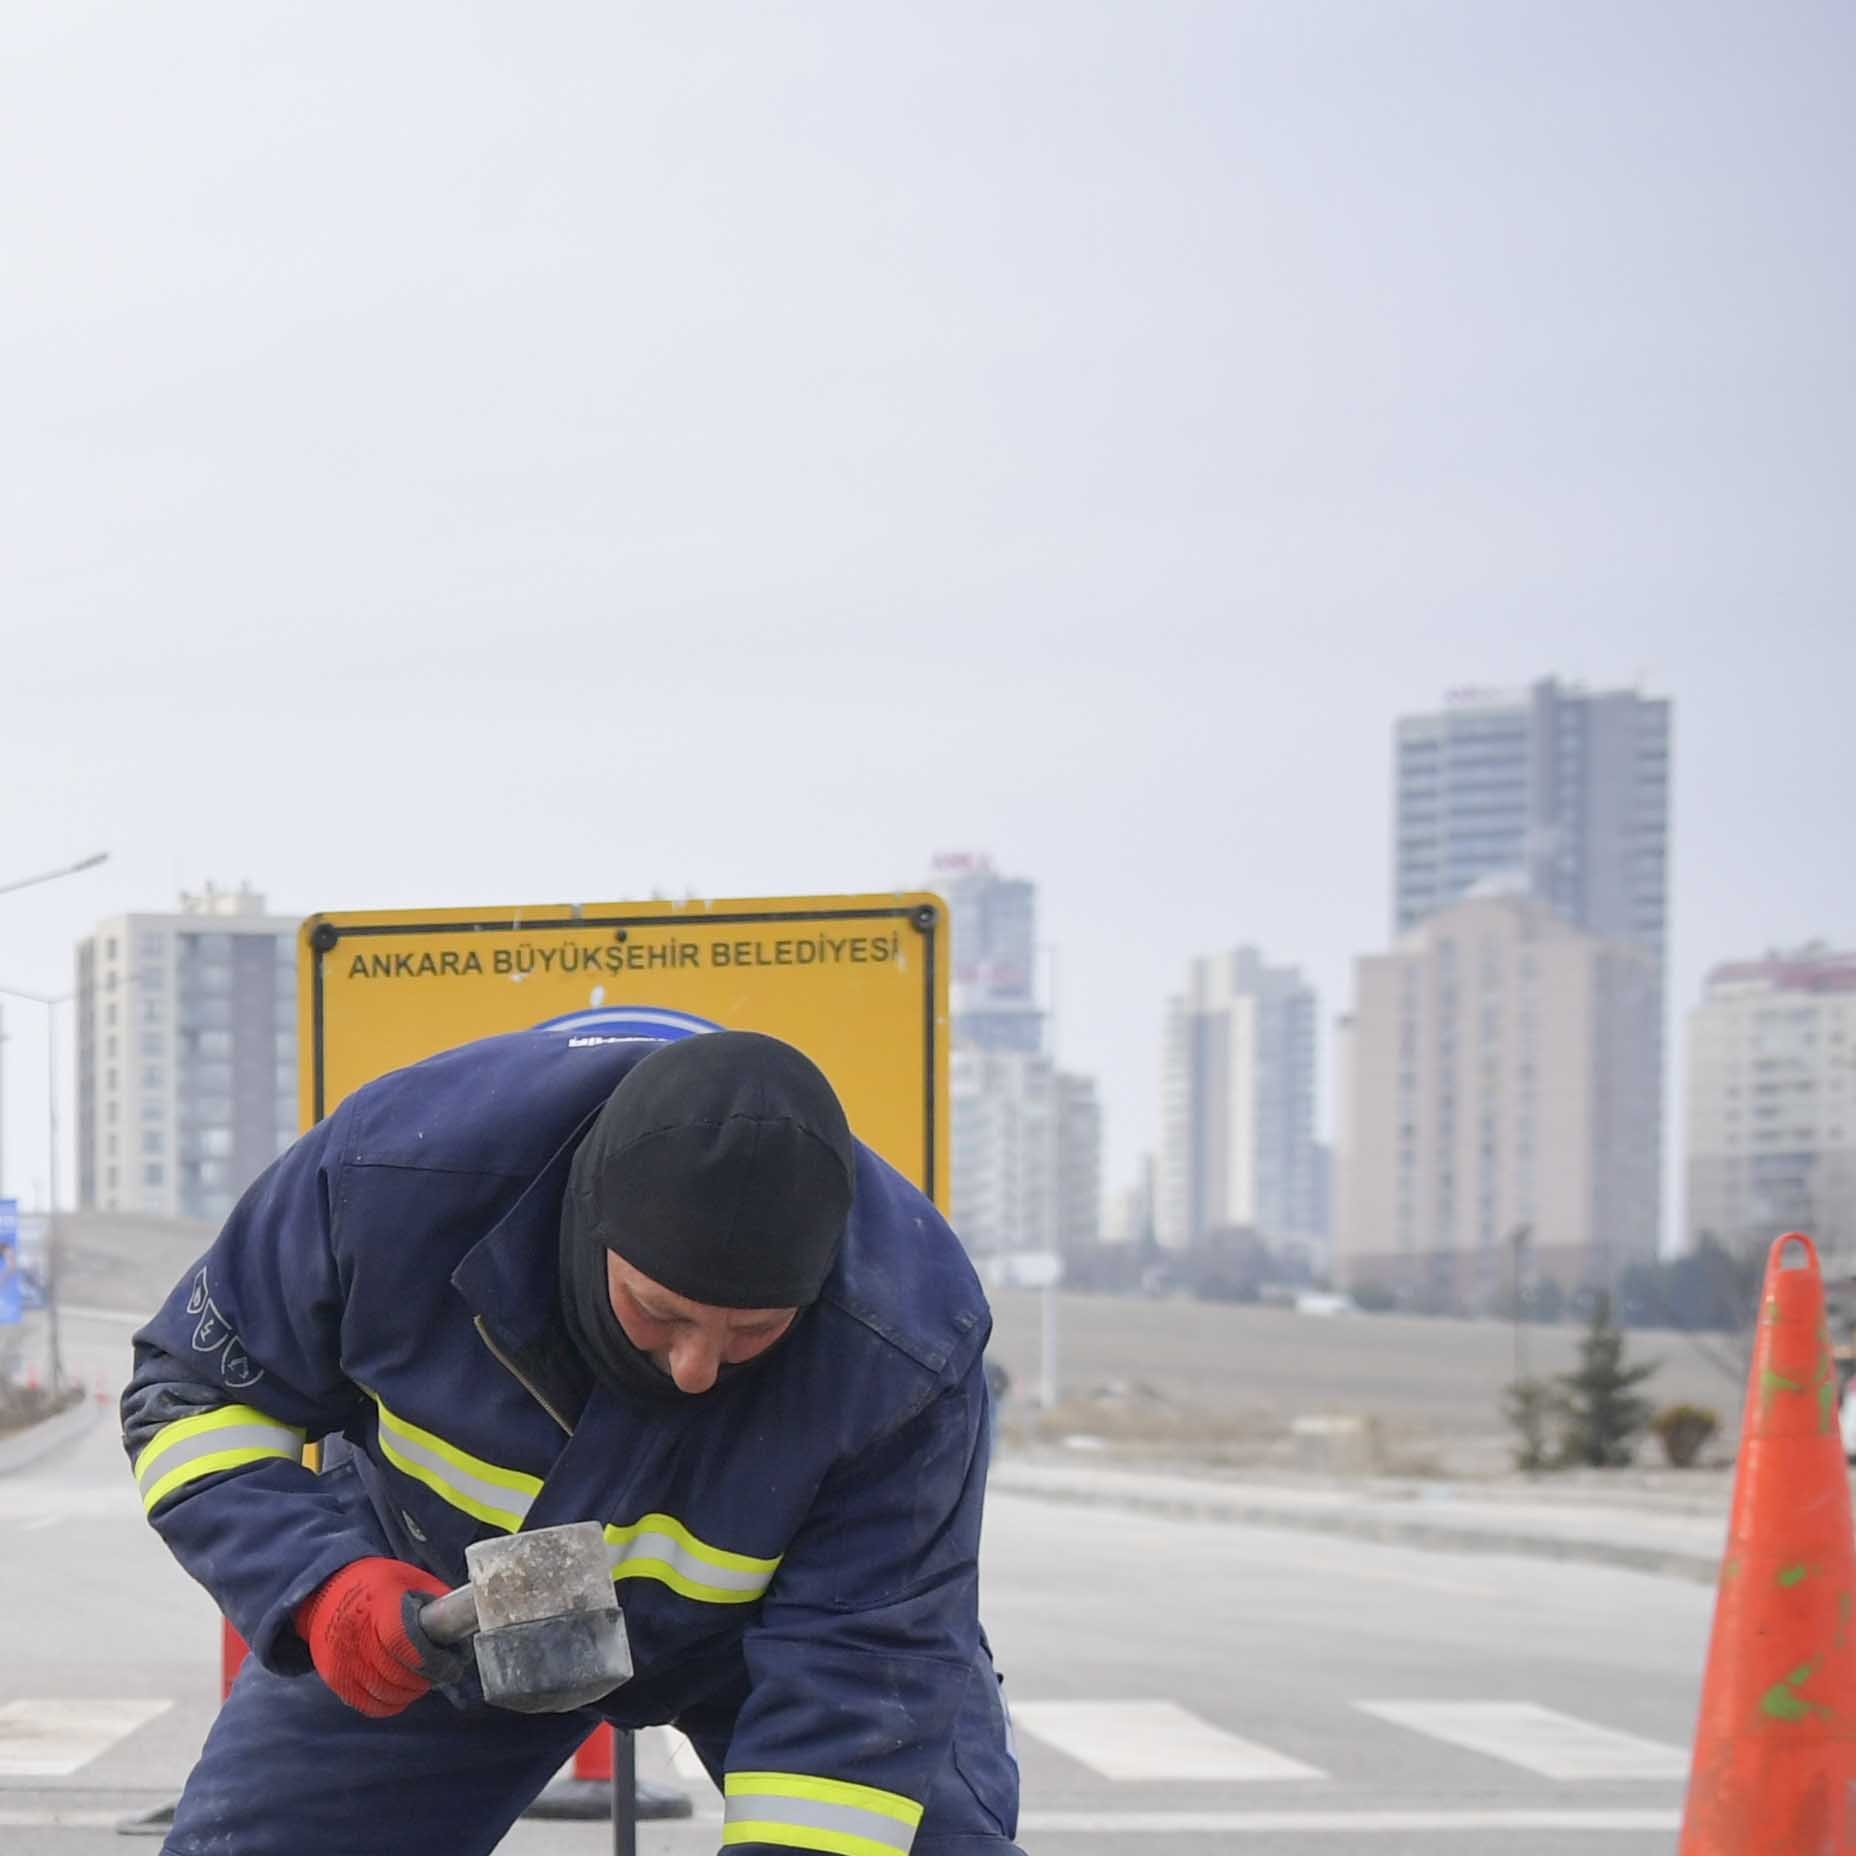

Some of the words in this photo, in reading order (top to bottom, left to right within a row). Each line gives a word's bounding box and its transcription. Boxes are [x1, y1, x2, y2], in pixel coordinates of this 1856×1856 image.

[347, 952, 483, 979] ANKARA
[492, 940, 701, 977] BÜYÜKŞEHİR
[712, 929, 900, 967] BELEDİYESİ
